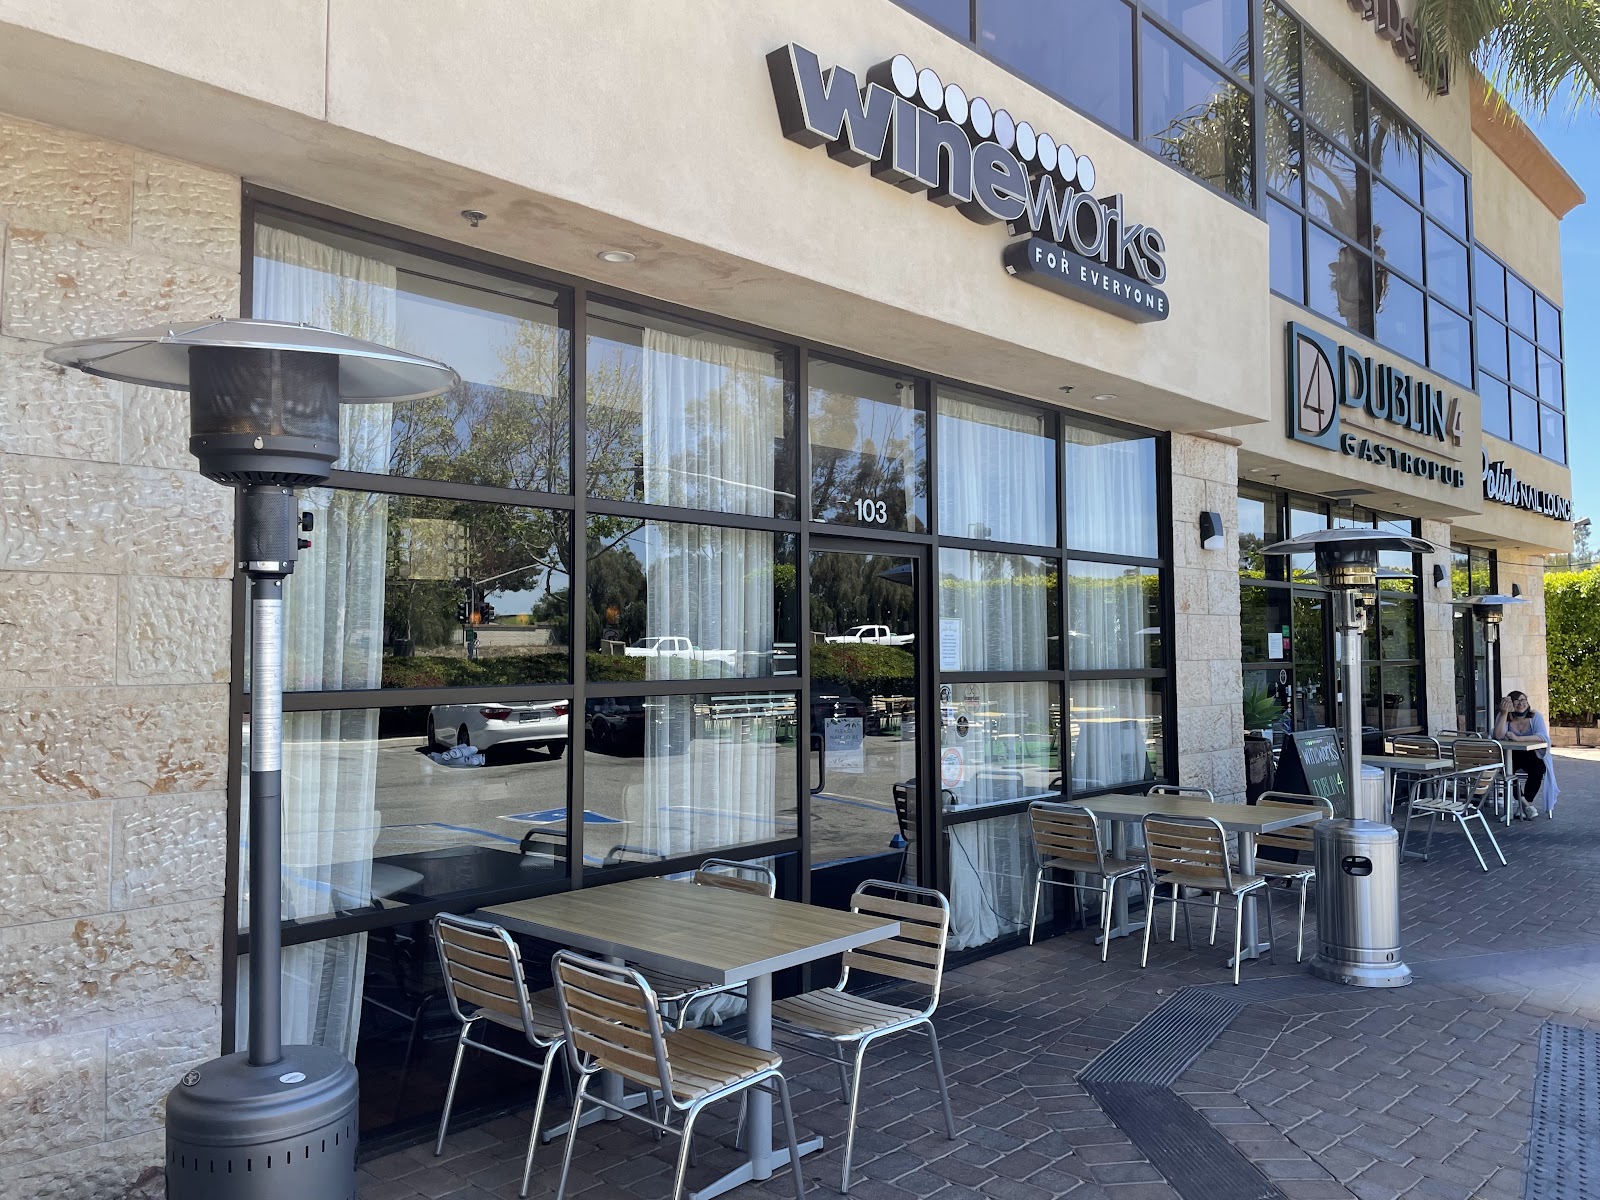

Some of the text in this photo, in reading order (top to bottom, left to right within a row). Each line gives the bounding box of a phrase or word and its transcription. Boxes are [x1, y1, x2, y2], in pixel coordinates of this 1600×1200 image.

[786, 41, 1168, 286] wineworks
[1034, 247, 1165, 313] FOR EVERYONE
[1338, 345, 1465, 448] DUBLIN 4
[1340, 432, 1465, 489] GASTROPUB
[854, 498, 888, 524] 103
[1520, 483, 1543, 513] NAIL
[1336, 772, 1346, 795] 4
